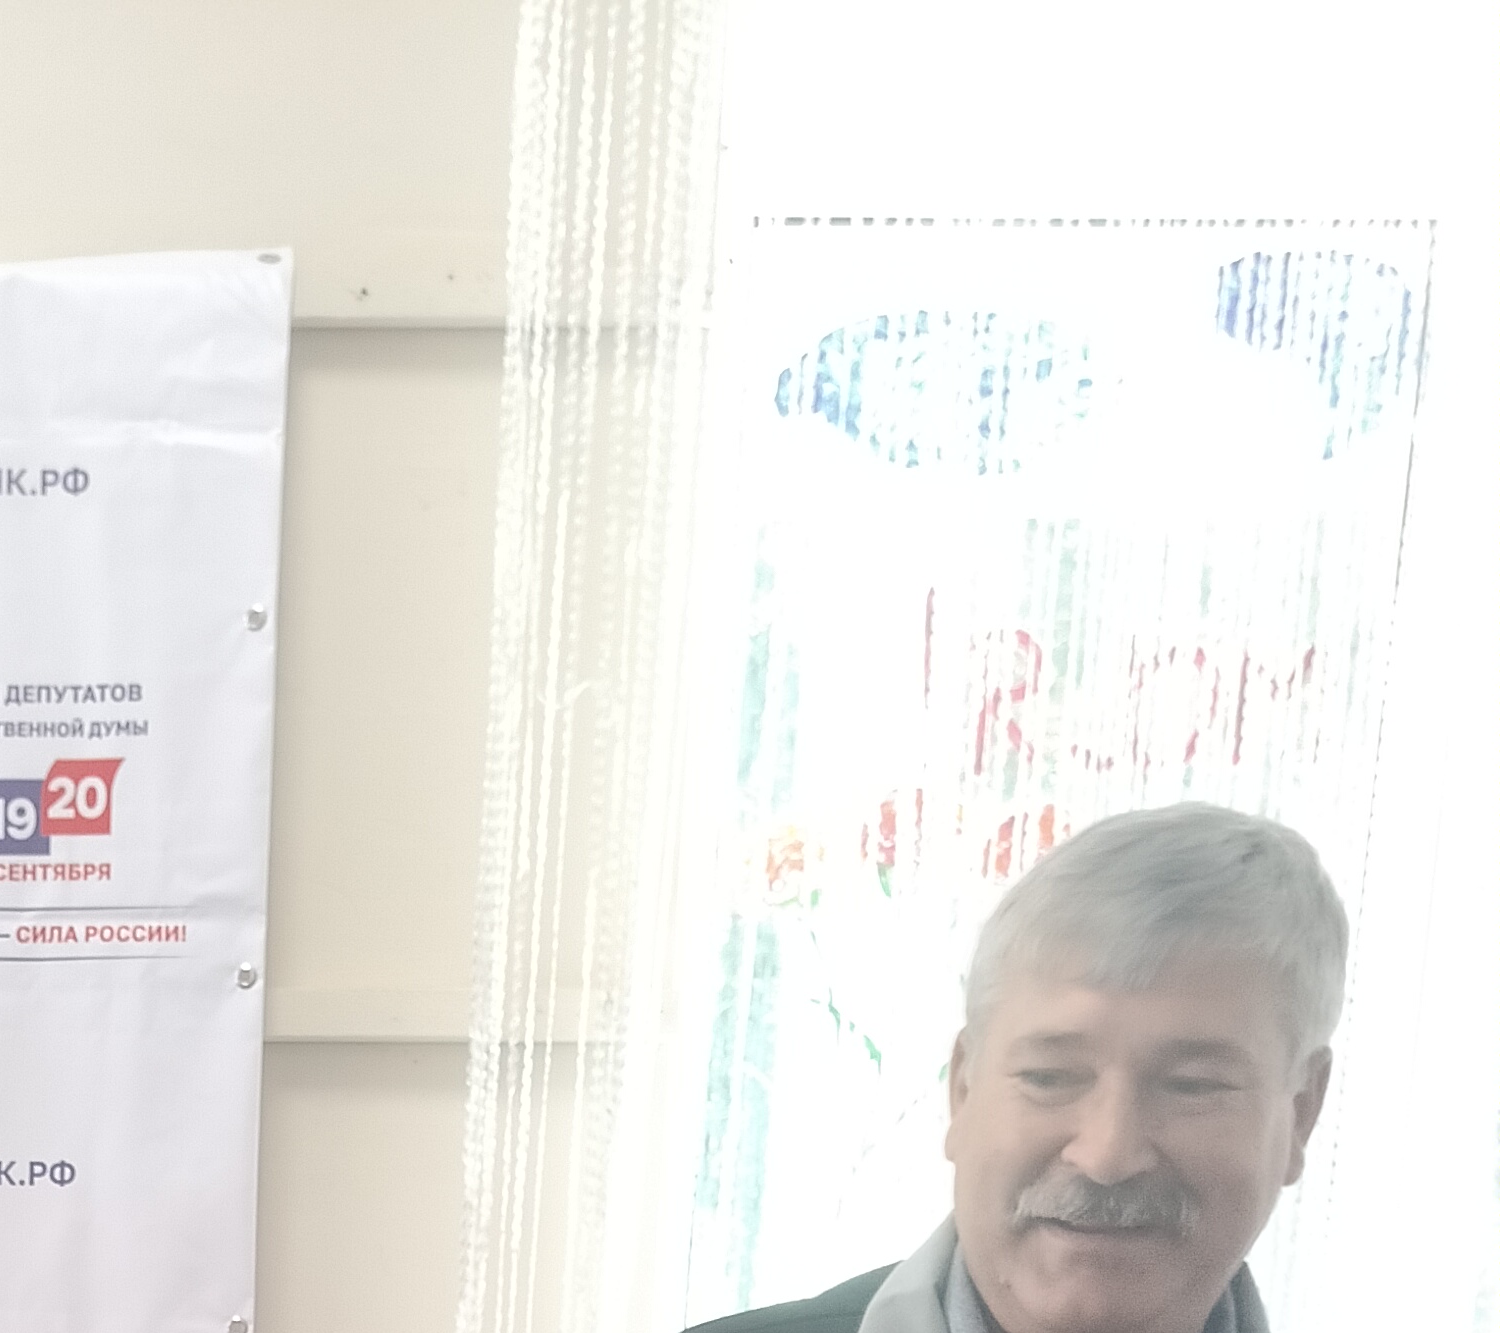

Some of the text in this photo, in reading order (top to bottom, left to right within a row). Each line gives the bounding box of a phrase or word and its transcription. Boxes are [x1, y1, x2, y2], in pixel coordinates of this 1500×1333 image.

[5, 684, 142, 706] ДЕПУТАТОВ
[88, 720, 148, 739] ДУМЫ
[47, 777, 107, 820] 20
[16, 925, 78, 944] СИЛА
[84, 924, 186, 944] РОССИИ!
